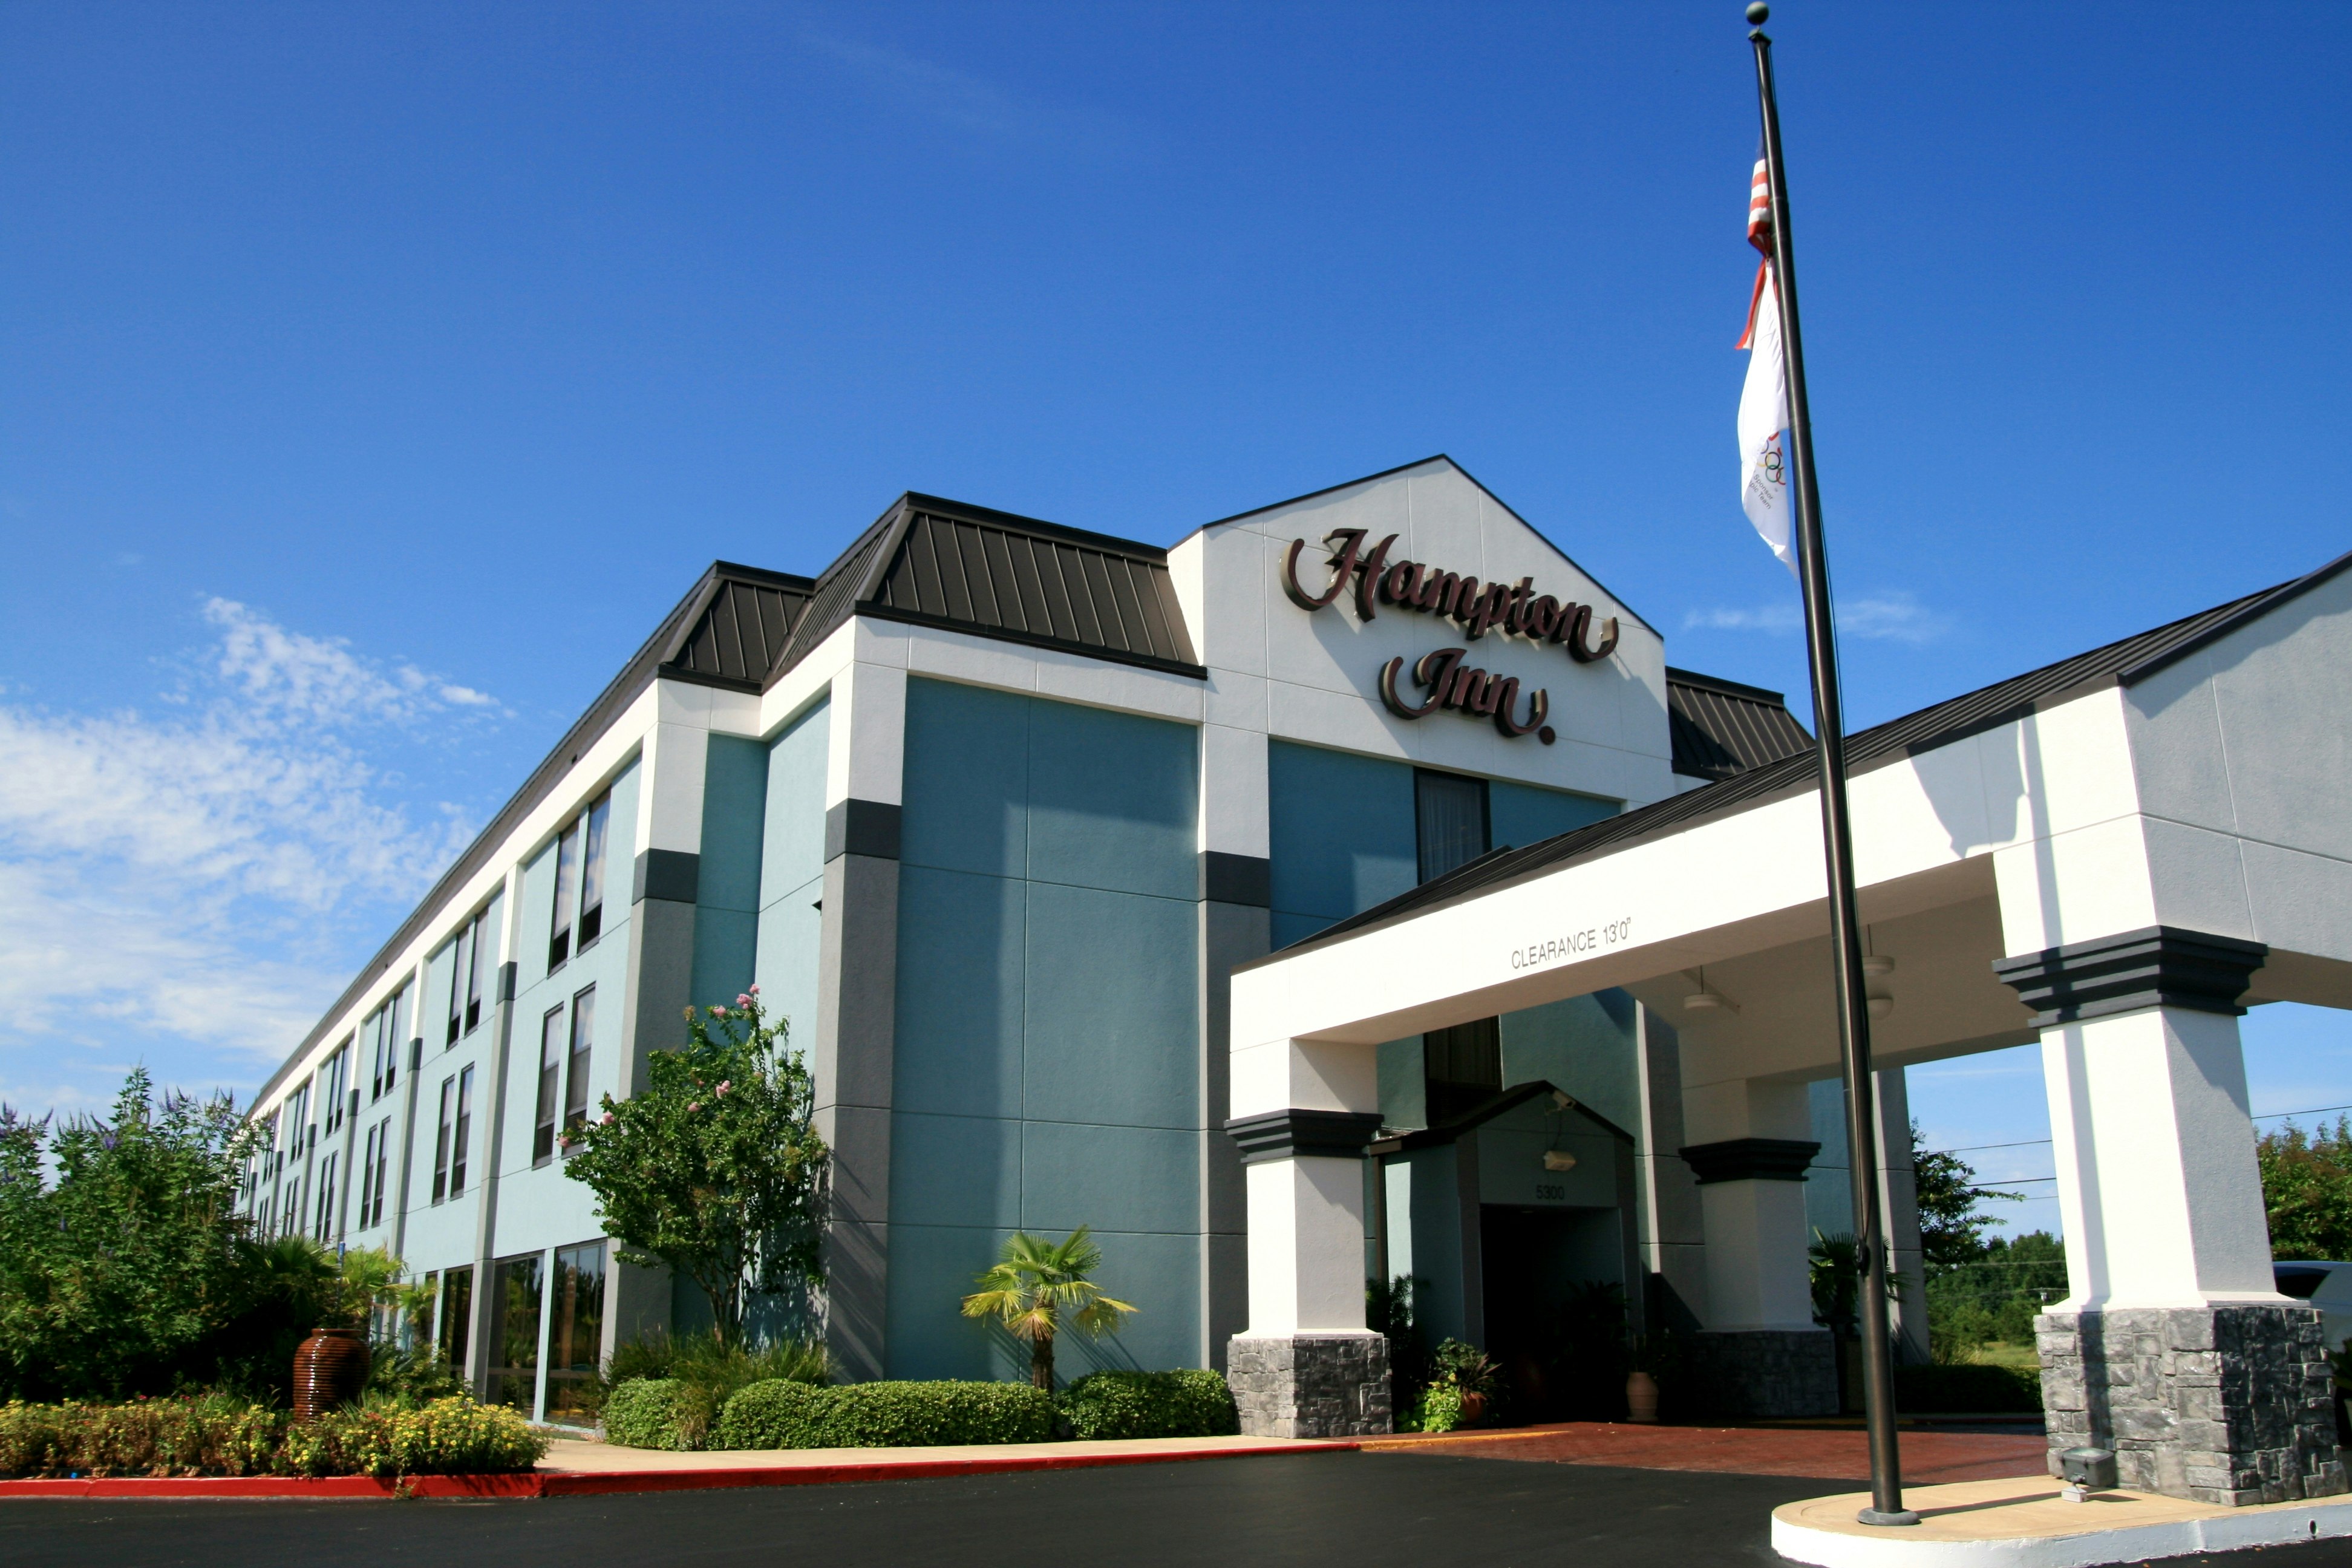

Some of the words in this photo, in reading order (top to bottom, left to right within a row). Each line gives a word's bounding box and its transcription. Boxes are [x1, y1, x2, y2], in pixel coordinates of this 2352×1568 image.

[1754, 474, 1773, 500] Sponsor
[1758, 492, 1771, 509] Team
[1280, 528, 1619, 663] Hampton
[1511, 929, 1596, 969] CLEARANCE
[1536, 1184, 1565, 1200] 5300
